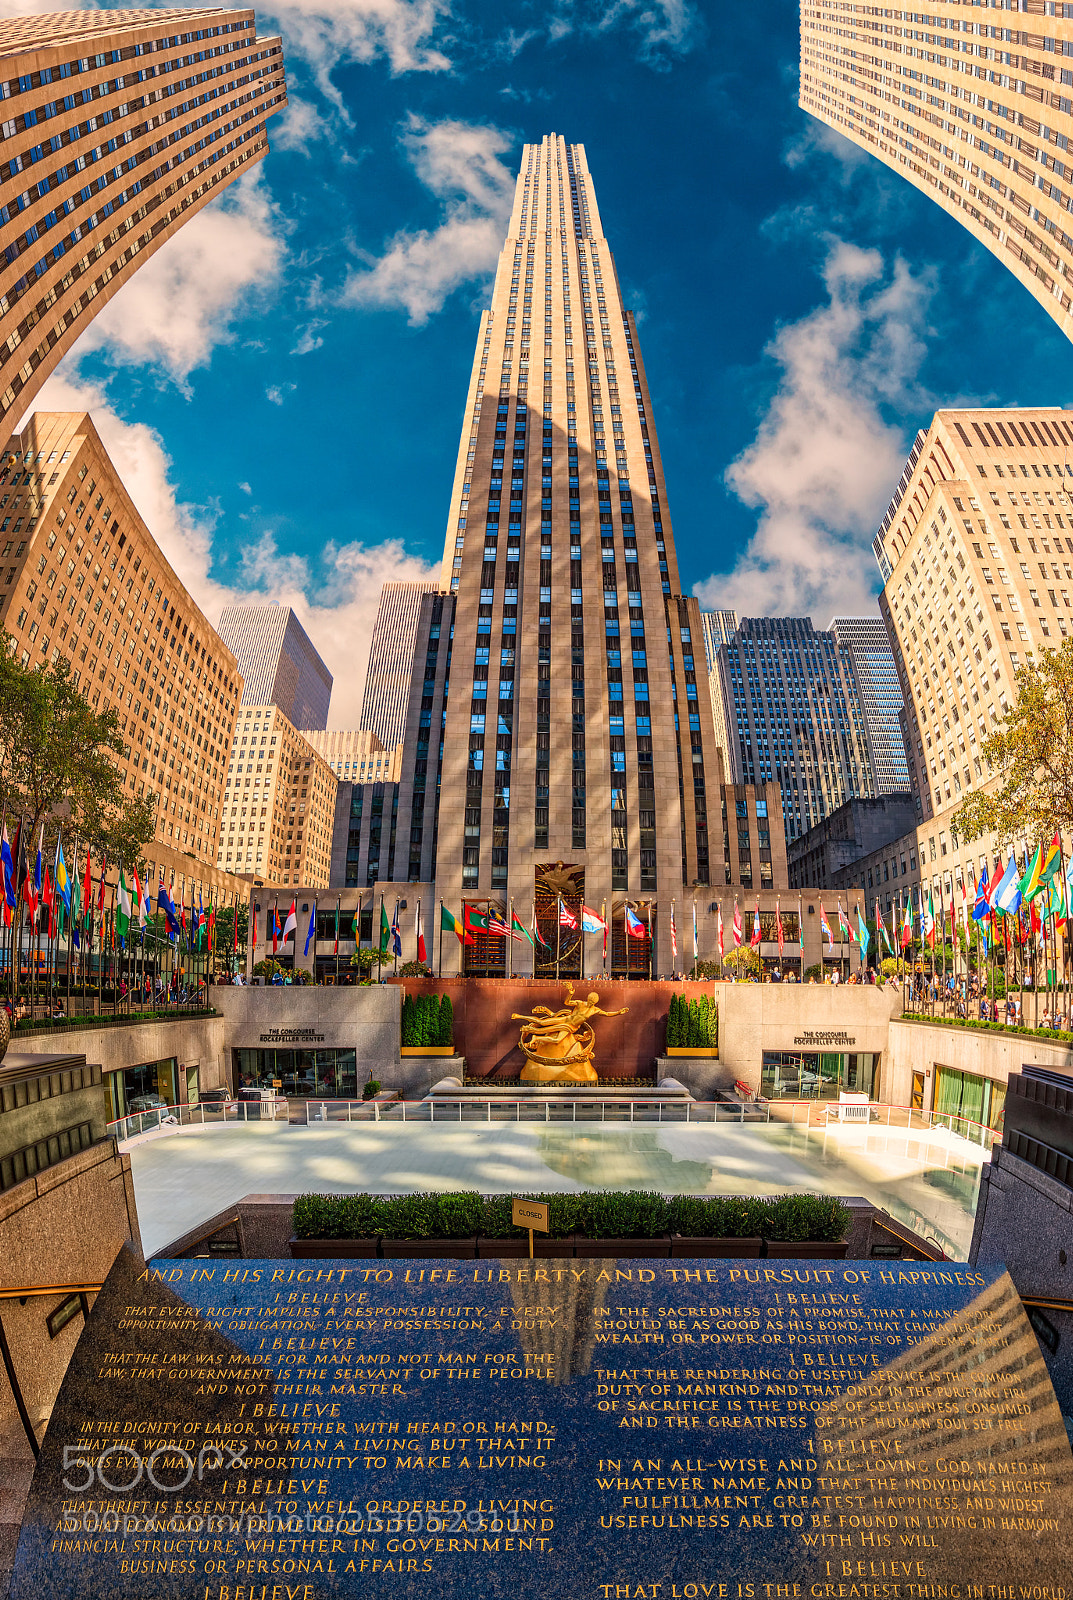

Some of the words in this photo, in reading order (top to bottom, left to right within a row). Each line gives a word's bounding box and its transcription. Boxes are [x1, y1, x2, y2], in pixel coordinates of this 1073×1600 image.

[519, 1209, 542, 1219] CLOSED
[137, 1269, 183, 1282] AND
[190, 1269, 216, 1282] IN
[223, 1269, 263, 1282] HIS
[271, 1269, 353, 1282] RIGHT
[361, 1270, 393, 1282] TO
[405, 1270, 465, 1283] LIFE,
[473, 1270, 586, 1282] LIBERTY
[596, 1270, 655, 1282] AND
[666, 1270, 719, 1282] THE
[729, 1270, 834, 1282] PURSUIT
[844, 1271, 871, 1283] OF
[880, 1271, 985, 1286] HAPPINESS
[274, 1293, 281, 1303] I
[288, 1293, 368, 1303] BELIEVE
[775, 1294, 780, 1303] I
[788, 1294, 862, 1304] BELIEVE
[124, 1307, 157, 1316] THAT
[159, 1307, 204, 1317] EVERY
[206, 1307, 254, 1317] RIGHT
[258, 1307, 320, 1317] IMPLIES
[325, 1308, 334, 1316] A
[500, 1307, 559, 1316] EVERY
[118, 1320, 199, 1331] OPPORTUNITY,
[203, 1321, 223, 1329] AN
[325, 1321, 376, 1329] EVERY
[384, 1320, 486, 1331] POSSESSION,
[493, 1320, 501, 1329] A
[512, 1320, 557, 1329] DUTY
[260, 1338, 265, 1349] I
[272, 1338, 357, 1349] BELIEVE
[104, 1353, 133, 1363] THAT
[135, 1353, 158, 1363] THE
[163, 1354, 191, 1363] LAW
[196, 1354, 222, 1364] WAS
[228, 1355, 272, 1364] MADE
[278, 1355, 308, 1364] FOR
[314, 1355, 351, 1364] MAN
[356, 1354, 390, 1364] AND
[398, 1354, 432, 1364] NOT
[437, 1354, 476, 1363] MAN
[484, 1354, 519, 1363] FOR
[523, 1354, 556, 1363] THE
[790, 1354, 795, 1365] I
[804, 1354, 882, 1366] BELIEVE
[130, 1369, 165, 1379] THAT
[169, 1369, 273, 1379] GOVERNMENT
[277, 1369, 291, 1379] IS
[297, 1369, 327, 1379] THE
[334, 1369, 413, 1379] SERVANT
[420, 1369, 442, 1379] OF
[446, 1369, 481, 1378] THE
[489, 1369, 555, 1378] PEOPLE
[196, 1385, 228, 1395] AND
[234, 1385, 267, 1395] NOT
[273, 1385, 323, 1395] THEIR
[330, 1384, 407, 1395] MASTER
[239, 1404, 245, 1416] I
[253, 1404, 341, 1417] BELIEVE
[598, 1401, 620, 1411] OF
[627, 1401, 720, 1411] SACRIFICE
[728, 1401, 741, 1411] IS
[747, 1401, 780, 1411] THE
[787, 1401, 838, 1411] DROSS
[846, 1402, 863, 1411] OF
[870, 1402, 959, 1413] SELFISHNESS
[966, 1403, 1031, 1415] CONSUMED
[81, 1422, 94, 1432] IN
[96, 1422, 119, 1433] THE
[123, 1422, 181, 1433] DIGNITY
[183, 1422, 201, 1433] OF
[205, 1423, 260, 1435] LABOR,
[264, 1423, 348, 1434] WHETHER
[354, 1422, 399, 1433] WITH
[407, 1422, 456, 1433] HEAD
[463, 1422, 488, 1433] OR
[618, 1417, 658, 1427] AND
[665, 1417, 699, 1427] THE
[709, 1417, 807, 1427] GREATNESS
[815, 1418, 834, 1428] OF
[875, 1418, 930, 1429] HUMAN
[937, 1419, 969, 1430] SOUL
[973, 1419, 993, 1431] SET
[808, 1439, 813, 1453] I
[823, 1439, 904, 1454] BELIEVE
[599, 1459, 621, 1471] IN
[632, 1459, 661, 1471] AN
[777, 1459, 817, 1471] AND
[978, 1463, 1028, 1474] NAMED
[1033, 1464, 1047, 1475] BY
[222, 1480, 228, 1494] I
[236, 1480, 328, 1494] BELIEVE
[596, 1478, 705, 1490] WHATEVER
[712, 1478, 771, 1491] NAME,
[776, 1478, 812, 1490] AND
[817, 1478, 861, 1490] THAT
[867, 1478, 898, 1490] THE
[1002, 1481, 1051, 1493] HIGHEST
[61, 1501, 95, 1513] THAT
[99, 1501, 150, 1513] THRIFT
[154, 1501, 168, 1513] IS
[175, 1501, 268, 1514] ESSENTIAL
[275, 1501, 297, 1513] TO
[307, 1501, 357, 1513] WELL
[366, 1500, 467, 1512] ORDERED
[478, 1500, 554, 1512] LIVING
[773, 1496, 865, 1508] GREATEST
[966, 1498, 994, 1510] AND
[999, 1499, 1044, 1512] WIDEST
[600, 1515, 730, 1528] USEFULNESS
[739, 1515, 774, 1527] ARE
[780, 1515, 803, 1527] TO
[812, 1515, 831, 1527] BE
[839, 1515, 898, 1528] FOUND
[904, 1516, 920, 1528] IN
[927, 1516, 977, 1529] LIVING
[982, 1517, 995, 1529] IN
[1001, 1517, 1059, 1531] HARMONY
[52, 1540, 127, 1553] FINANCIAL
[245, 1540, 346, 1553] WHETHER
[353, 1539, 376, 1552] IN
[386, 1538, 554, 1553] GOVERNMENT,
[800, 1534, 852, 1547] WITH
[900, 1534, 939, 1547] WILL
[120, 1560, 196, 1573] BUSINESS
[204, 1560, 229, 1573] OR
[235, 1560, 337, 1573] PERSONAL
[345, 1559, 433, 1572] AFFAIRS
[826, 1561, 831, 1576] I
[842, 1561, 927, 1576] BELIEVE
[204, 1586, 210, 1600] I
[219, 1585, 314, 1600] BELIEVE
[600, 1584, 662, 1598] THAT
[672, 1584, 728, 1598] LOVE
[738, 1584, 755, 1597] IS
[763, 1584, 801, 1597] THE
[811, 1584, 901, 1597] GREATEST
[906, 1584, 960, 1598] THING
[967, 1585, 983, 1599] IN
[988, 1585, 1015, 1599] THE
